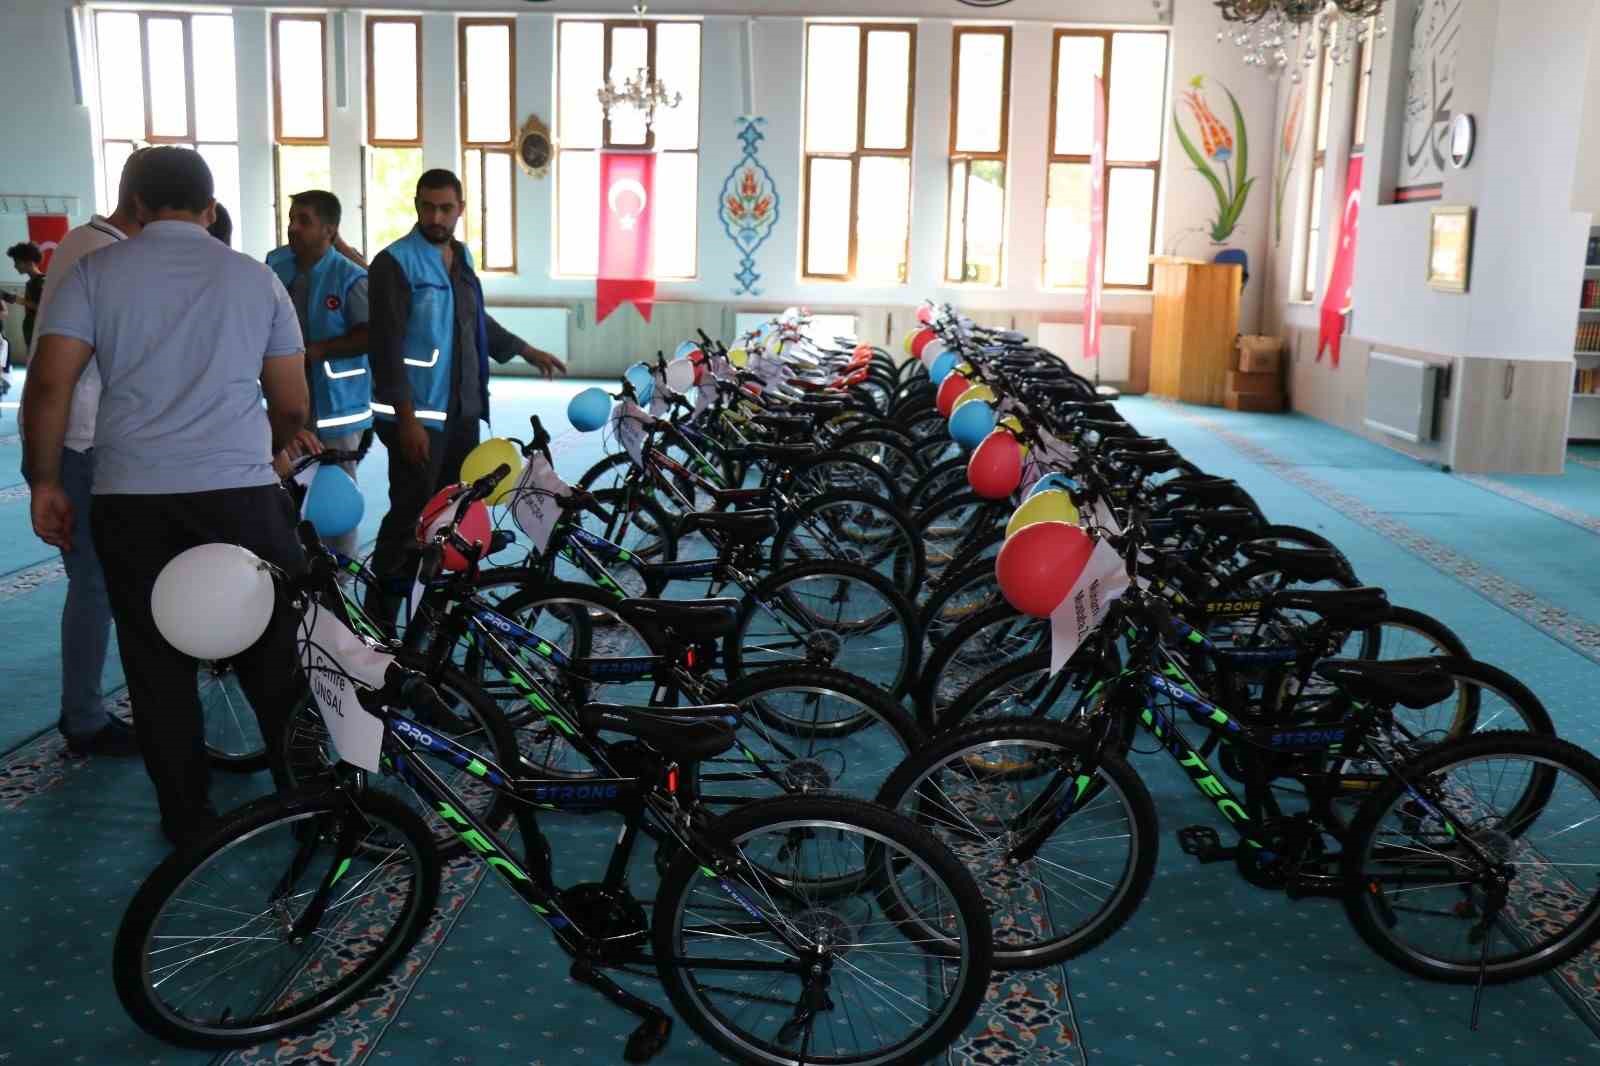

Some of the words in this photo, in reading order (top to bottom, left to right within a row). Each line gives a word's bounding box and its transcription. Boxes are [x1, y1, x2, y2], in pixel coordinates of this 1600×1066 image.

[1206, 601, 1262, 613] STRONG
[484, 612, 512, 633] PRO
[397, 721, 434, 747] PRO
[1270, 728, 1345, 746] STRONG
[534, 783, 620, 801] STRONG
